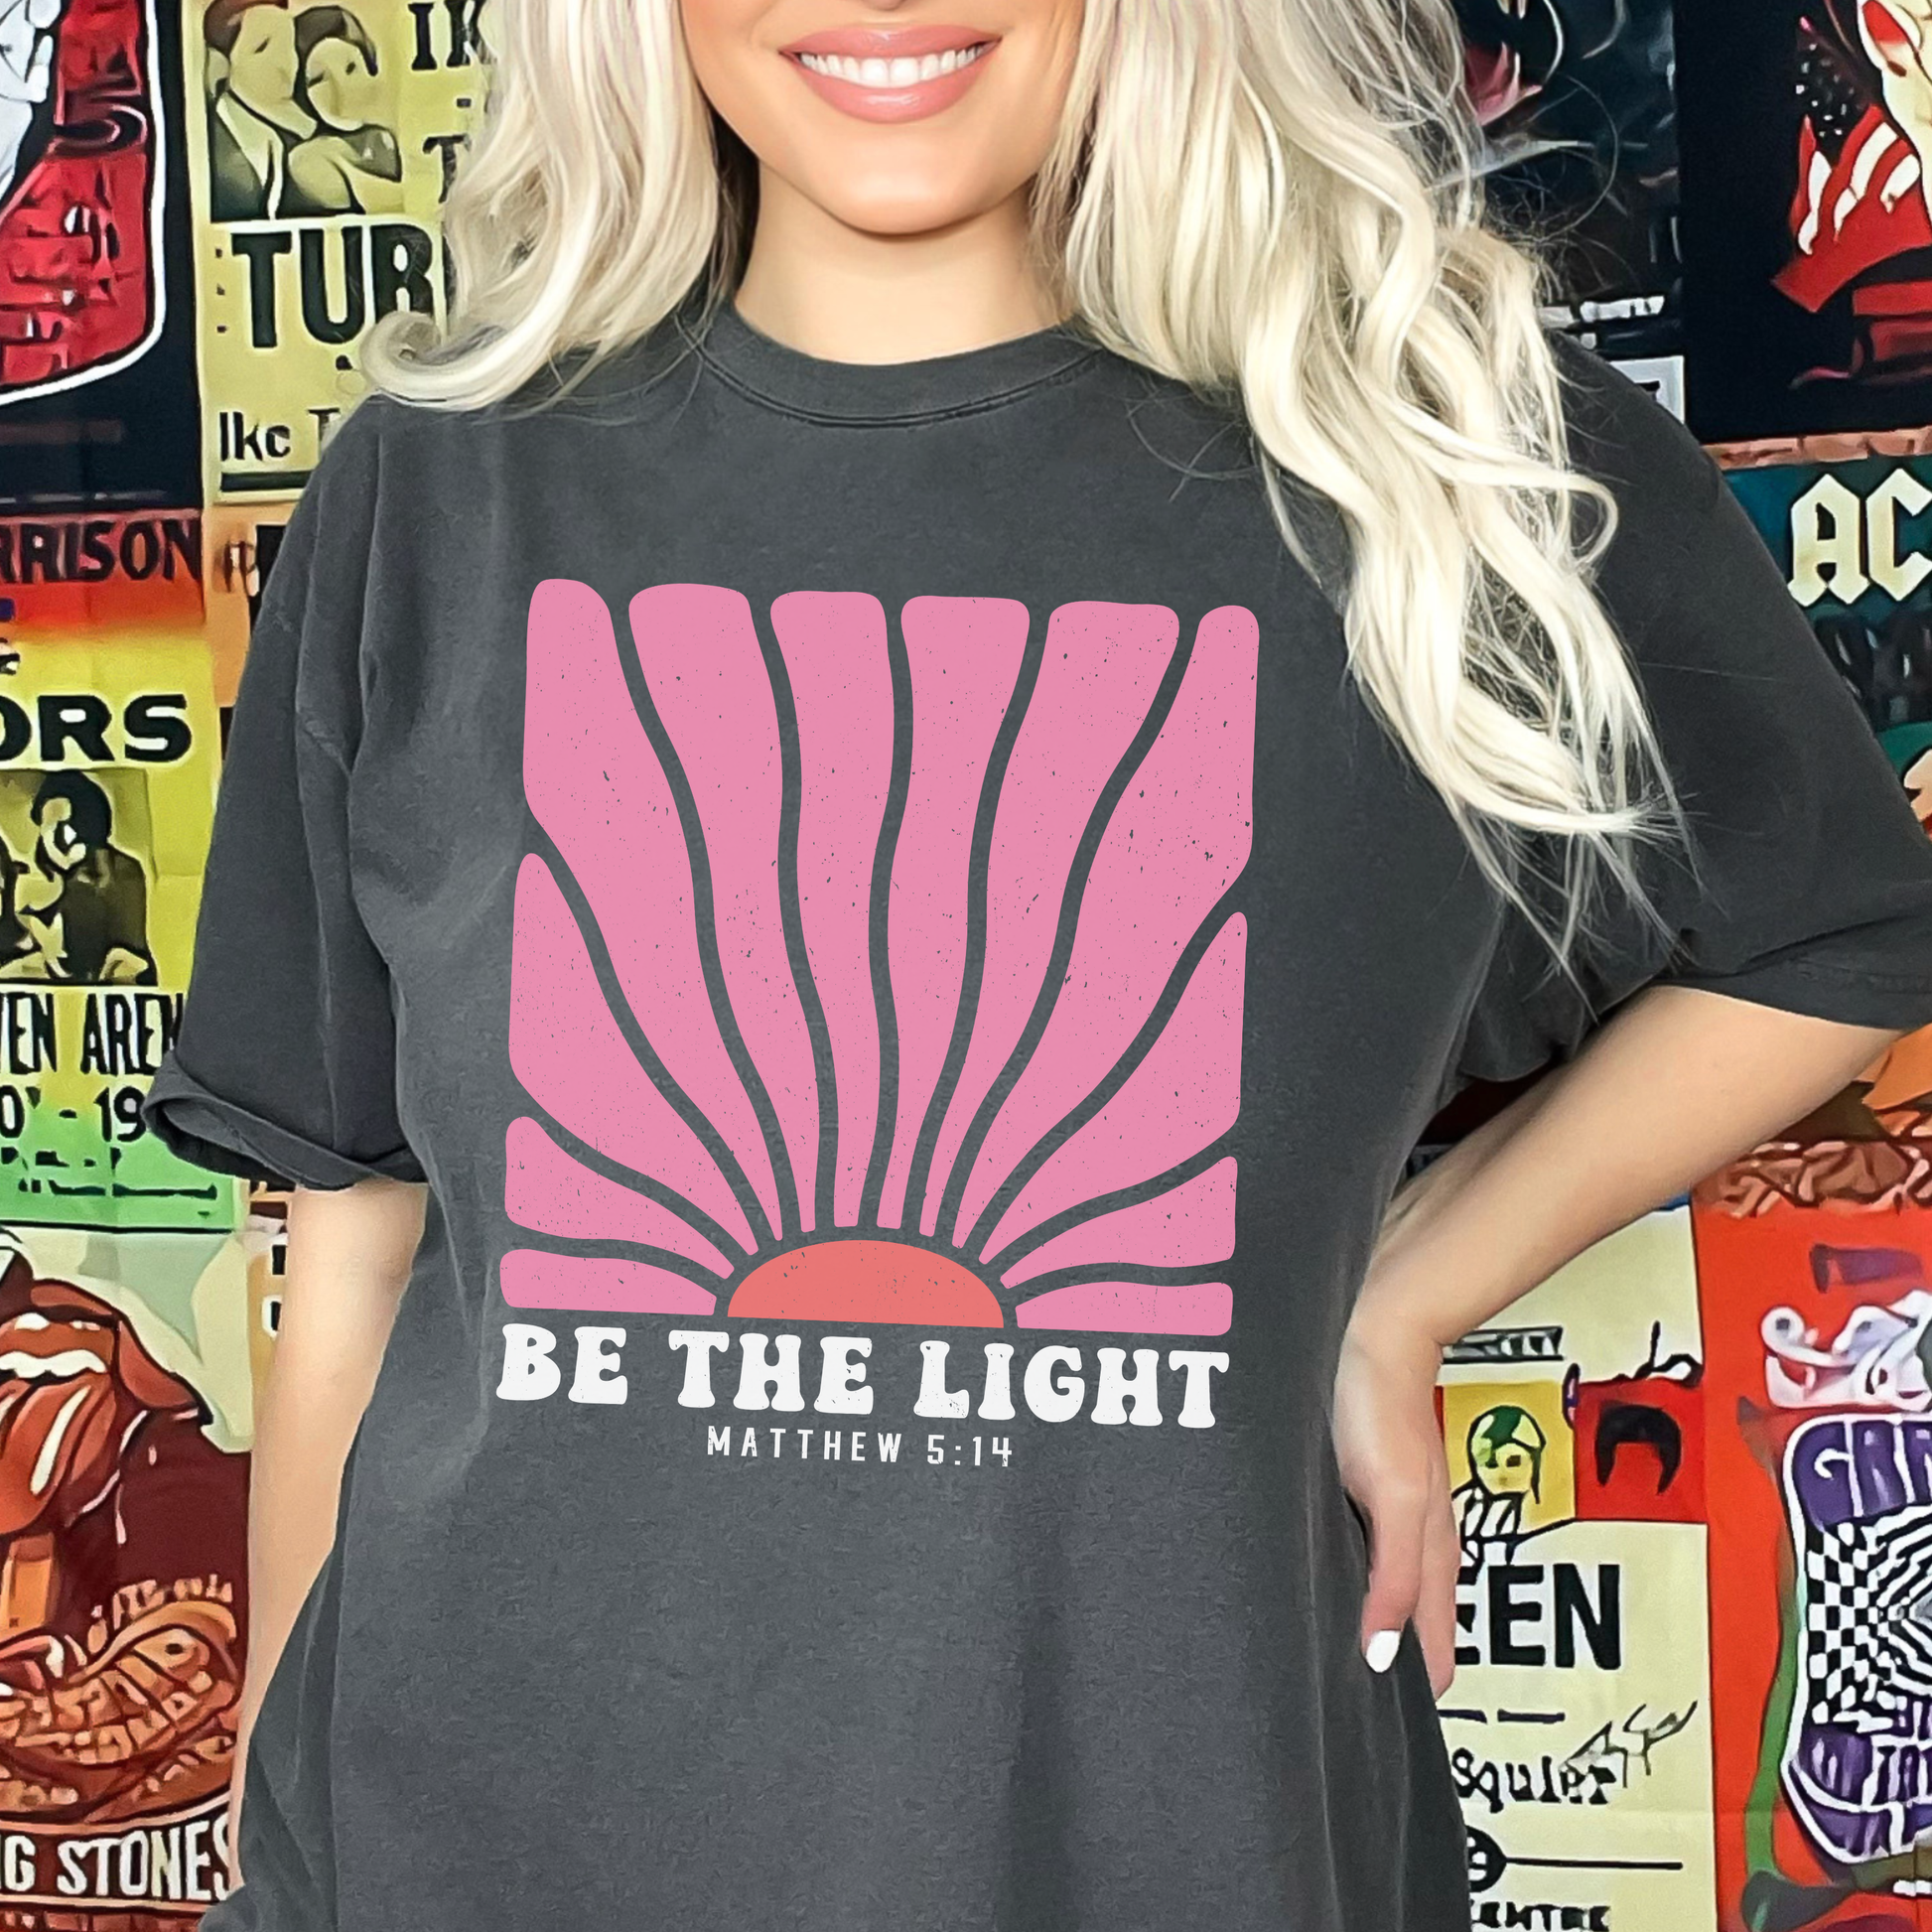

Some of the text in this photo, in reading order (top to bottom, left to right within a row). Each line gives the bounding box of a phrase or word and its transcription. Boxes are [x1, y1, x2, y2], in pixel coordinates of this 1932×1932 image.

[231, 223, 457, 348] TUR
[1786, 468, 1932, 607] AC
[0, 992, 57, 1074] EN
[496, 1323, 1230, 1429] BE THE LIGHT
[707, 1425, 1014, 1467] MATTHEW 5:14
[57, 1812, 229, 1901] STONES
